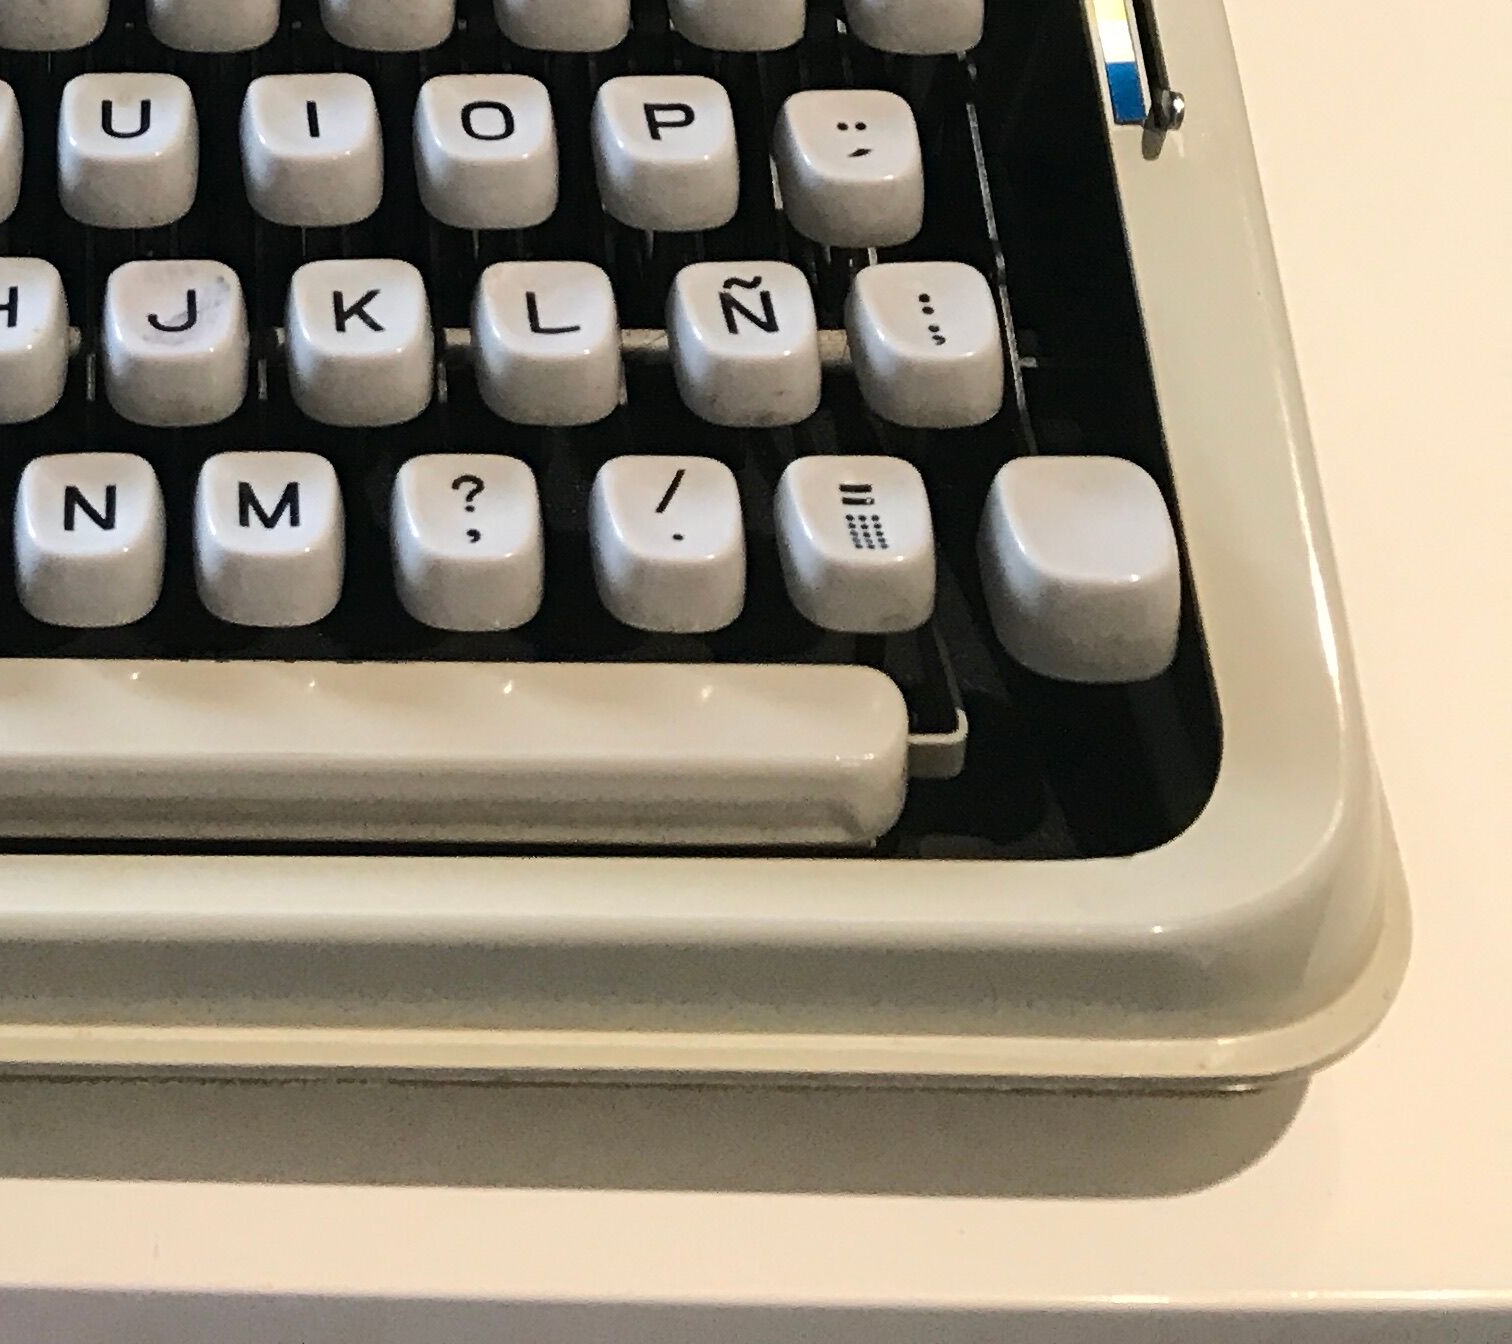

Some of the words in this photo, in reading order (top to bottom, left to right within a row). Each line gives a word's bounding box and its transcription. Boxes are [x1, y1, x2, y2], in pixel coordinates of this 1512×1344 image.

[101, 99, 152, 139] U
[306, 100, 320, 138] I
[460, 100, 515, 141] O
[643, 102, 695, 141] P
[147, 289, 198, 333] J
[332, 289, 384, 333] K
[525, 291, 581, 335] L
[718, 275, 780, 335] Ñ
[63, 484, 117, 532] N
[238, 481, 300, 529] M
[451, 474, 485, 513] ?
